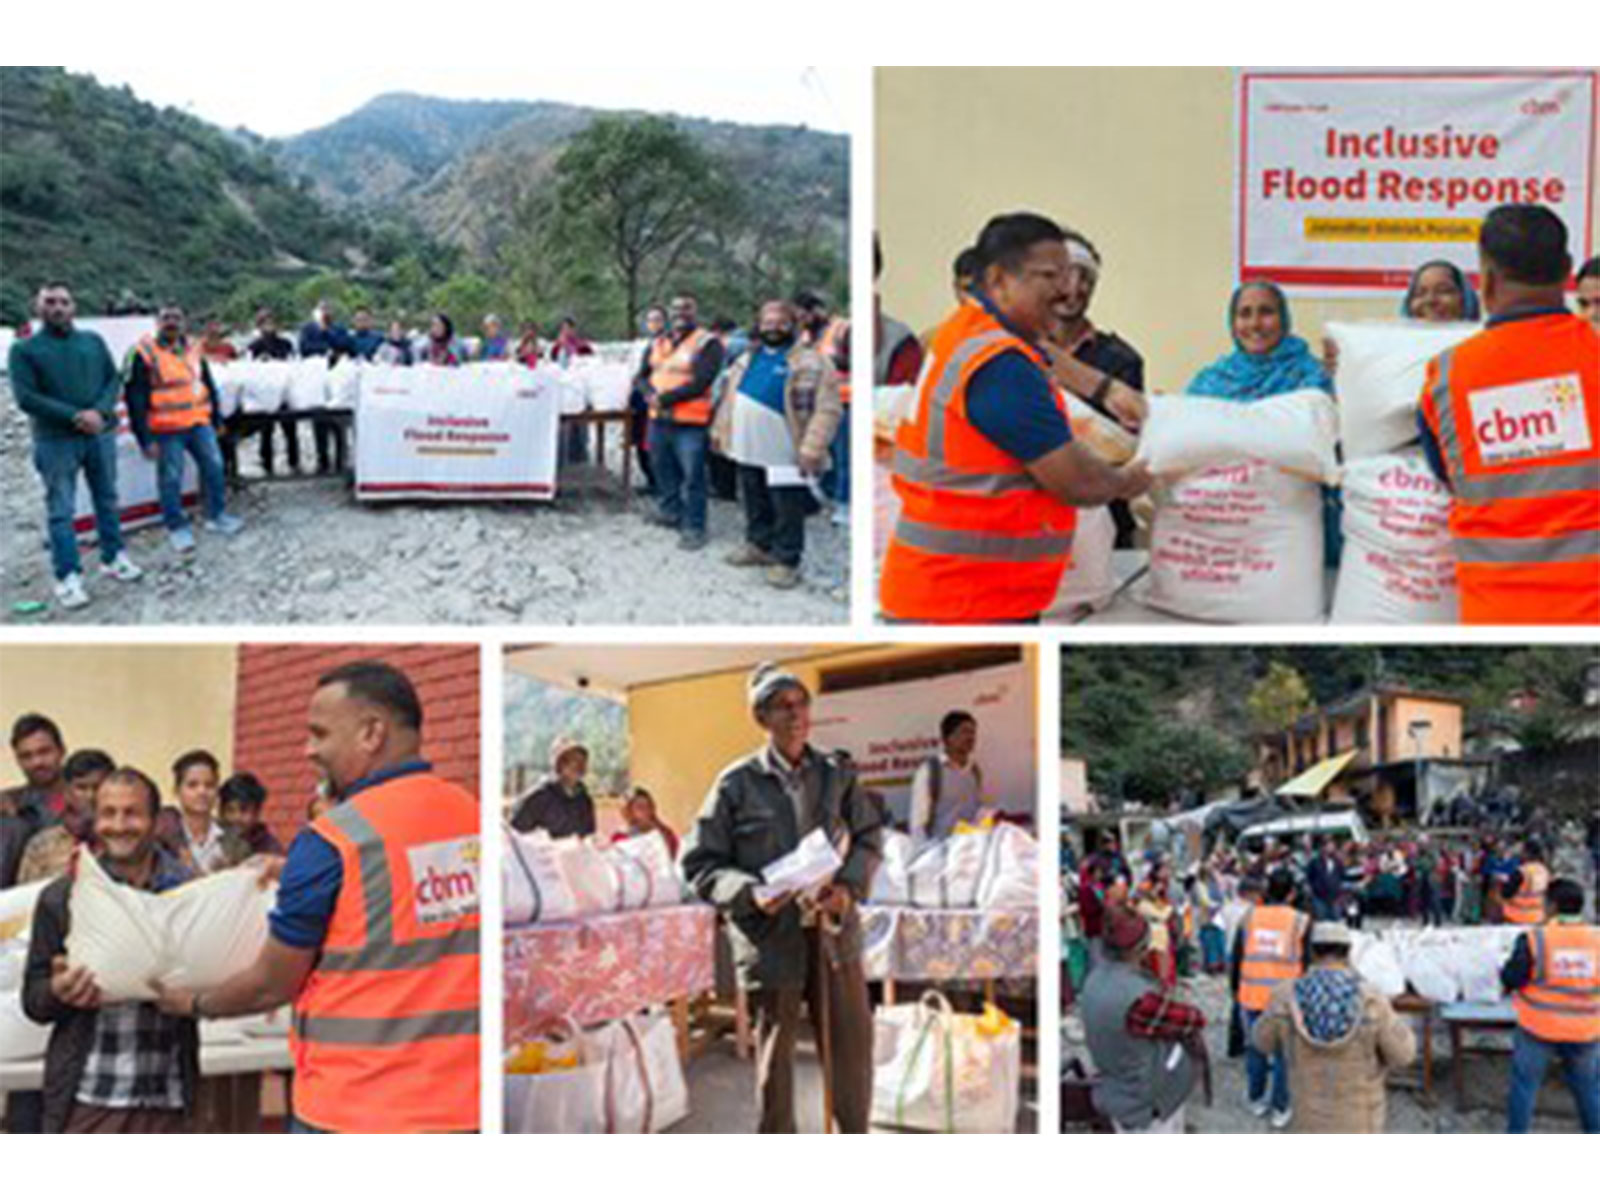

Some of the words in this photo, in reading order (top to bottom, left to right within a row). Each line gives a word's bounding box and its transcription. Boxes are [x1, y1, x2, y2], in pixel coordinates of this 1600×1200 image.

[1325, 125, 1500, 158] Inclusive
[1261, 169, 1367, 201] Flood
[1377, 170, 1566, 209] Response
[403, 428, 443, 442] Flood
[446, 430, 511, 444] Response
[427, 415, 490, 428] Inclusive
[1477, 406, 1557, 445] cbm
[868, 733, 943, 755] Inclusive
[415, 865, 475, 905] cbm
